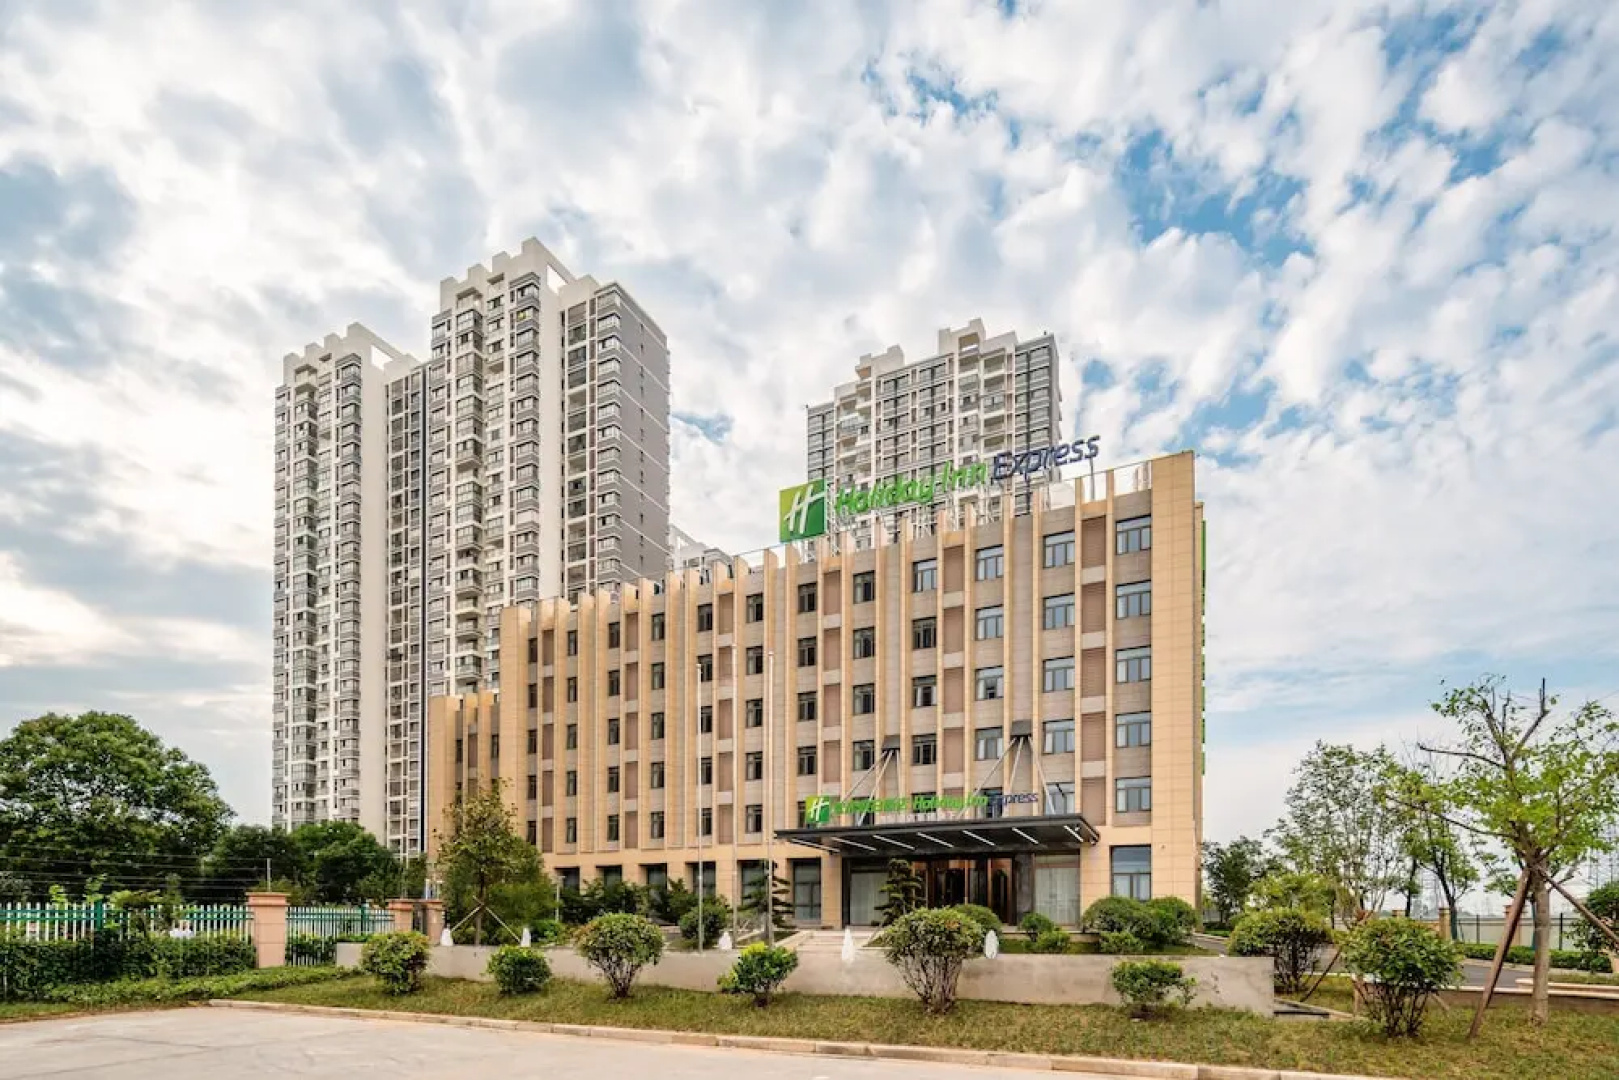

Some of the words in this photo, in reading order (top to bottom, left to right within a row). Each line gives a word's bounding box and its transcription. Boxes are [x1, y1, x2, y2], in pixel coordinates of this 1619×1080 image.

[835, 474, 934, 515] Holiday
[943, 460, 987, 492] Inn
[993, 435, 1100, 481] Express
